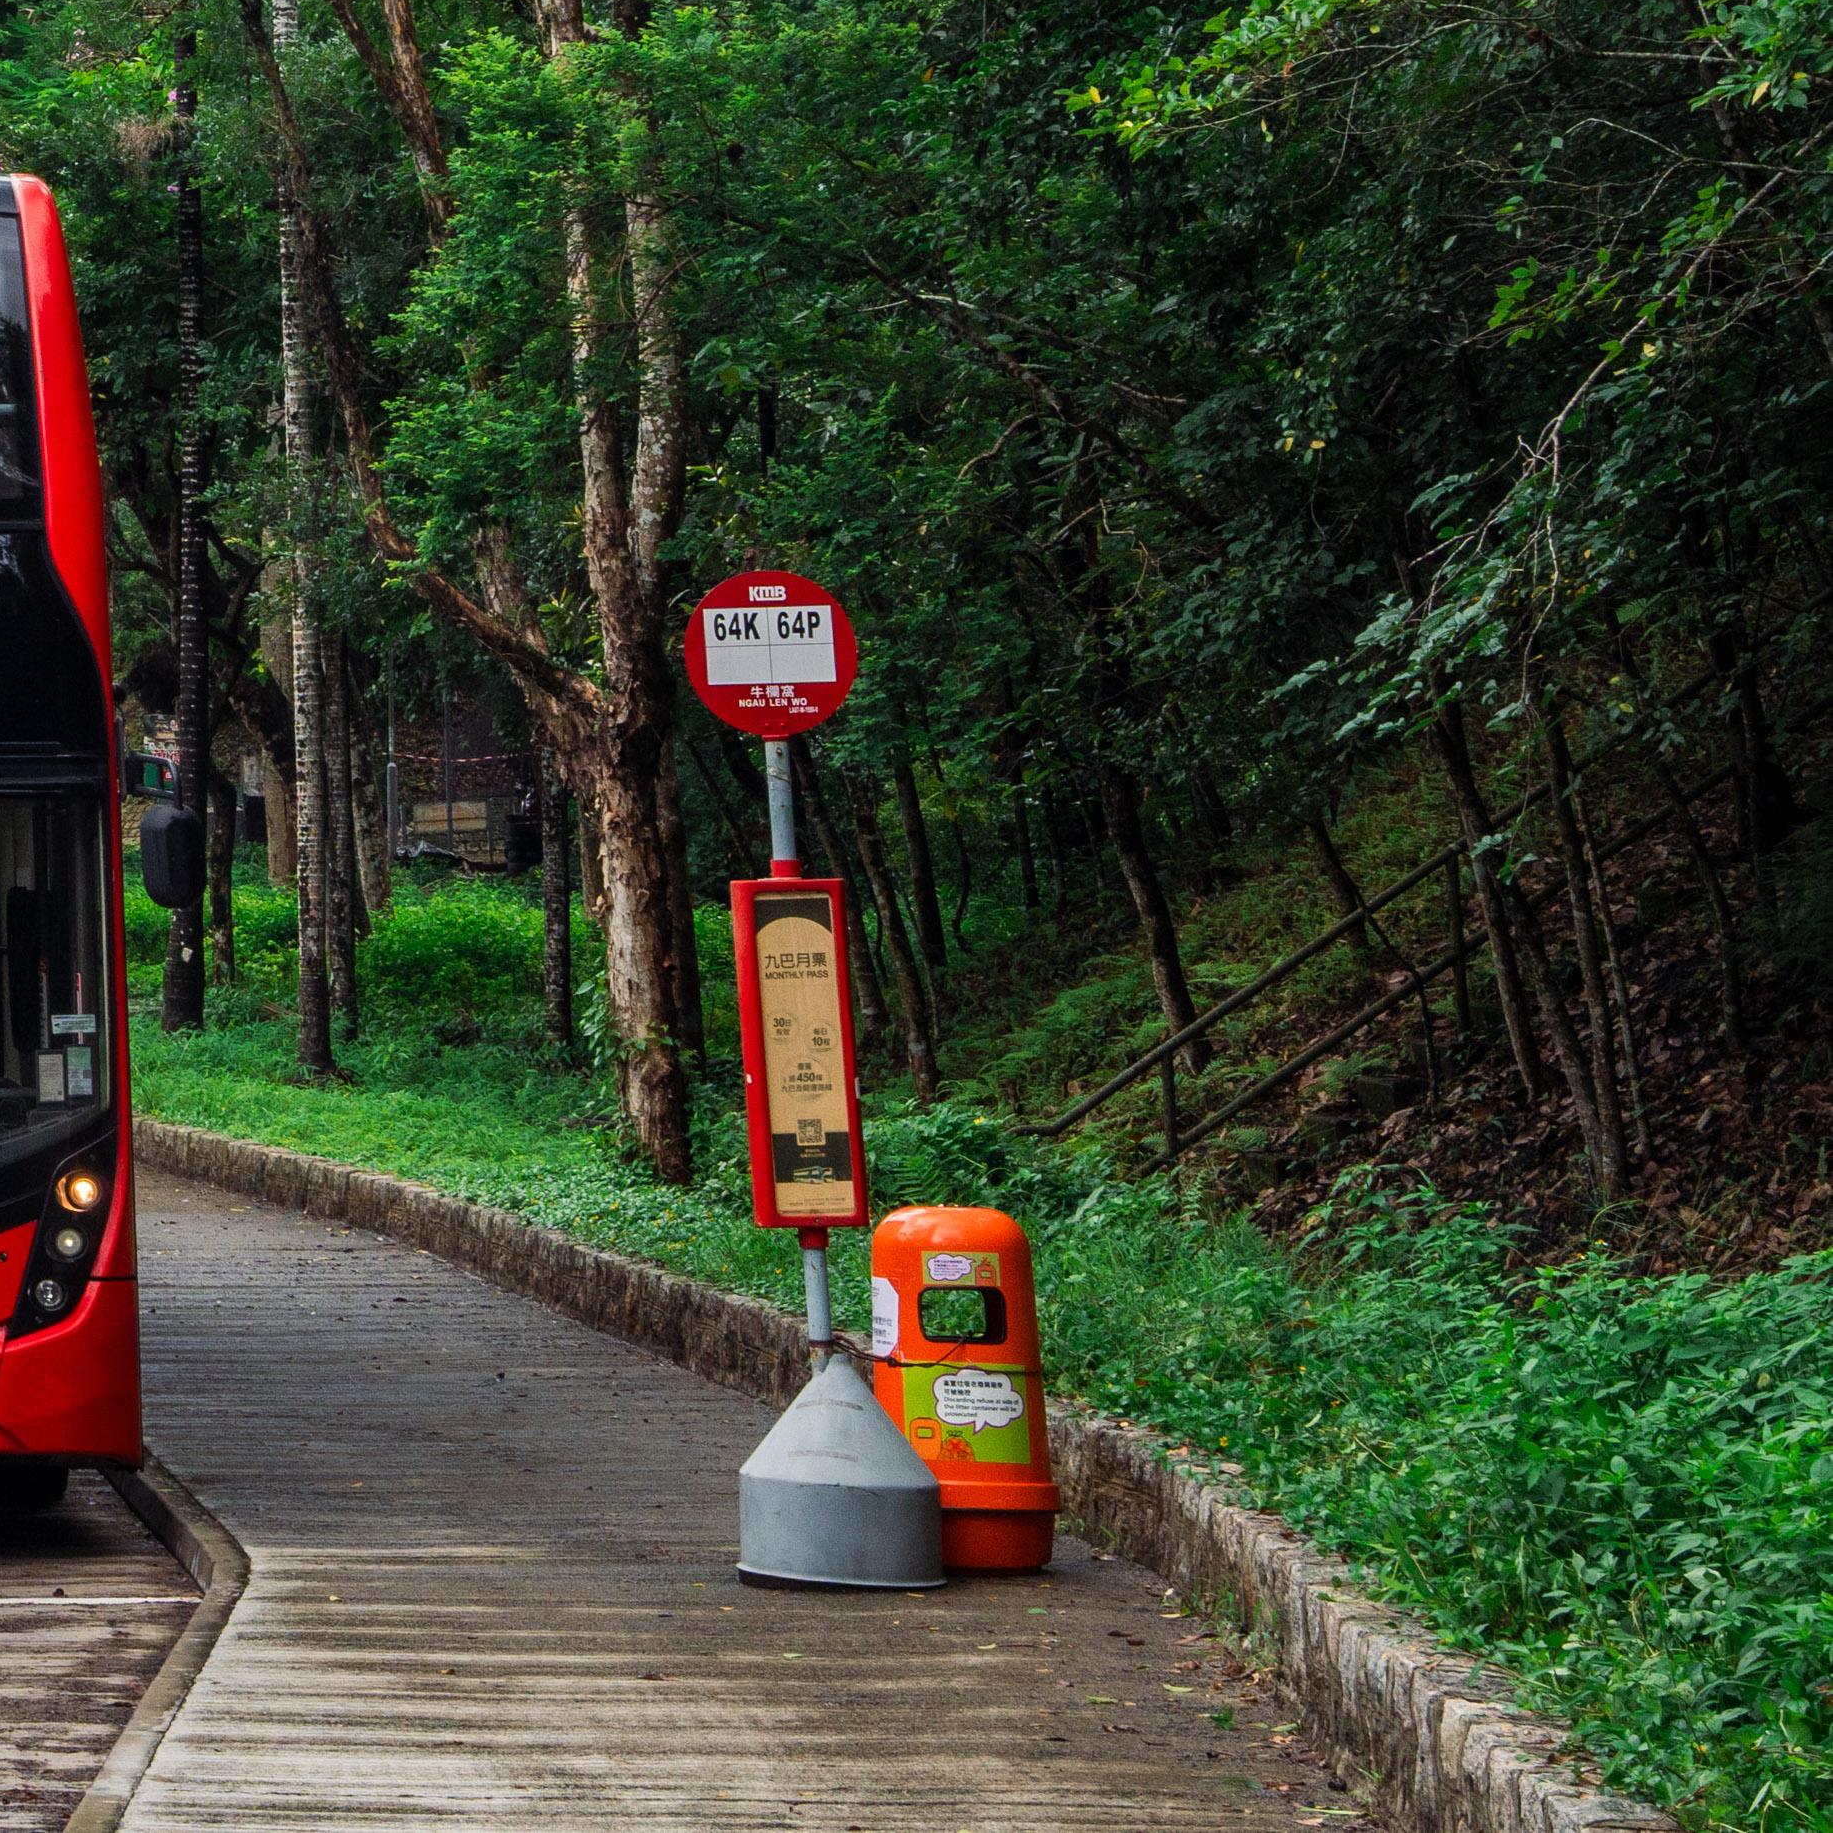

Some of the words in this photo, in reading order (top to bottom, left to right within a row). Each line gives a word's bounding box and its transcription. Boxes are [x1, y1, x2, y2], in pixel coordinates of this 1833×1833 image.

[748, 585, 787, 602] KMB
[713, 612, 761, 641] 64K
[777, 611, 821, 639] 64P
[738, 698, 766, 707] NGAU
[769, 698, 788, 707] LEN
[791, 697, 808, 706] WO
[765, 952, 827, 969] 九巴月票
[765, 971, 805, 980] MONTHLY
[807, 970, 829, 979] PASS
